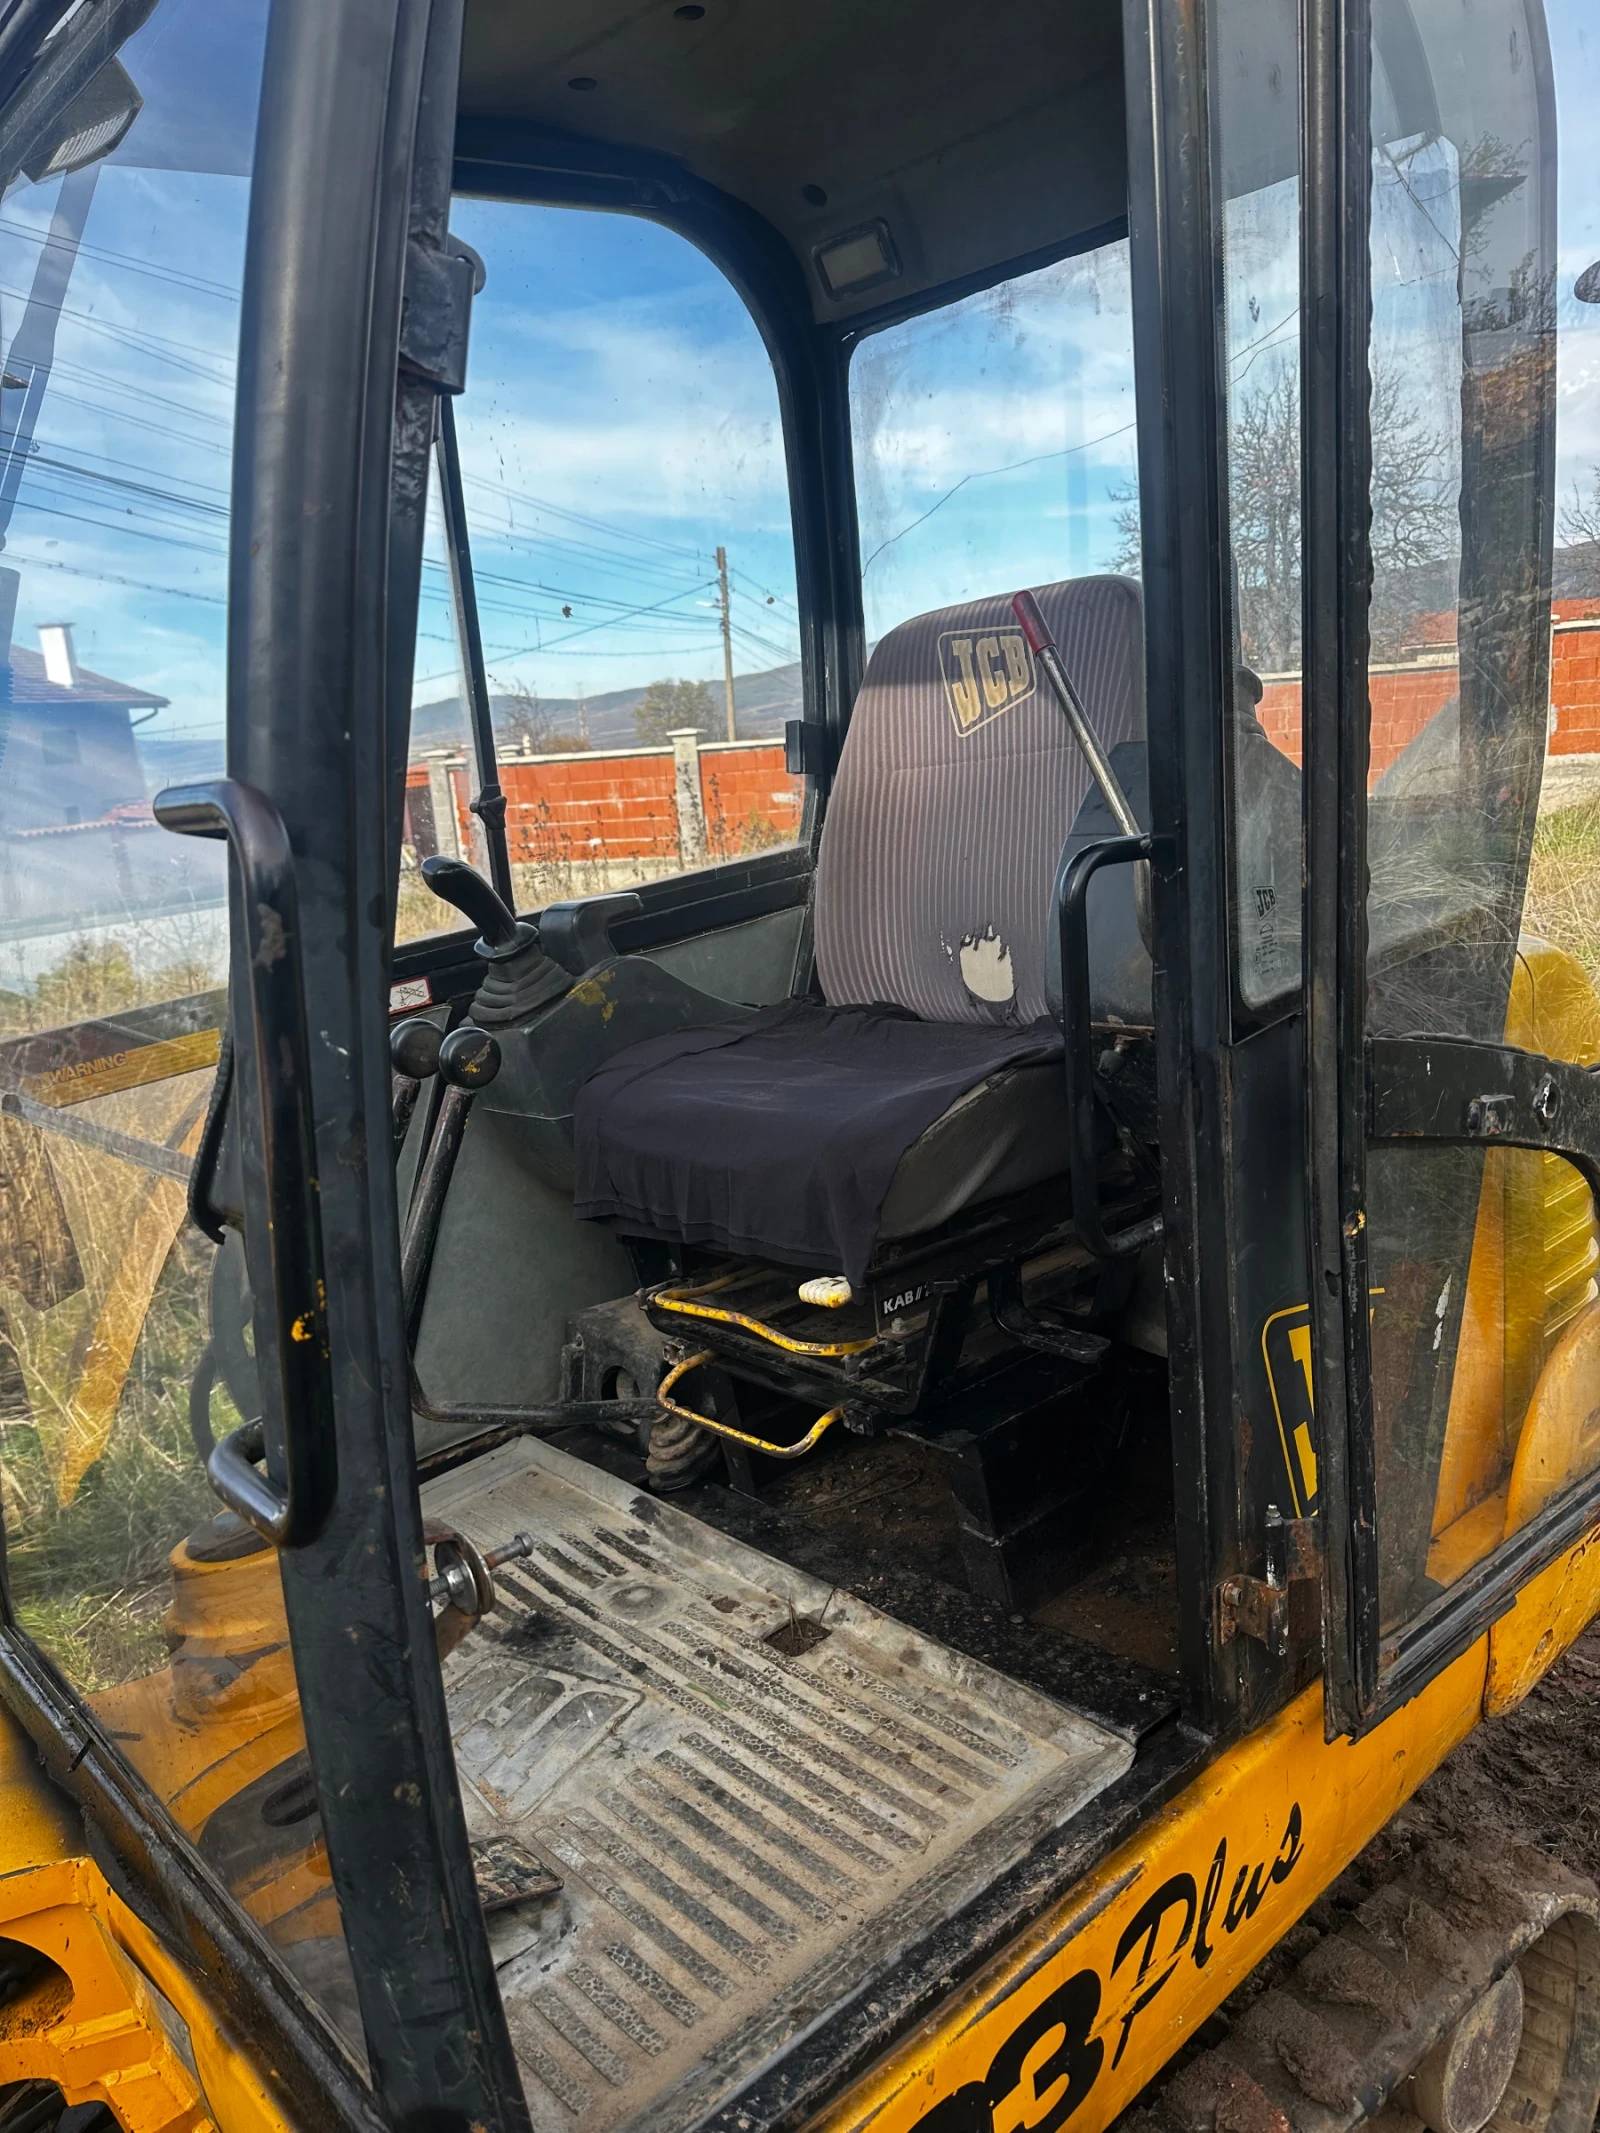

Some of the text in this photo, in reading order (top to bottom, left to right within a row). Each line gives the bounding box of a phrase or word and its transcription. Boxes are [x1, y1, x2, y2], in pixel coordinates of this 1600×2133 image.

[951, 635, 1030, 728] JCB
[1256, 889, 1276, 918] JCB
[50, 1052, 127, 1085] WARNING
[883, 1290, 914, 1314] KAB
[1110, 1801, 1305, 2071] Plus
